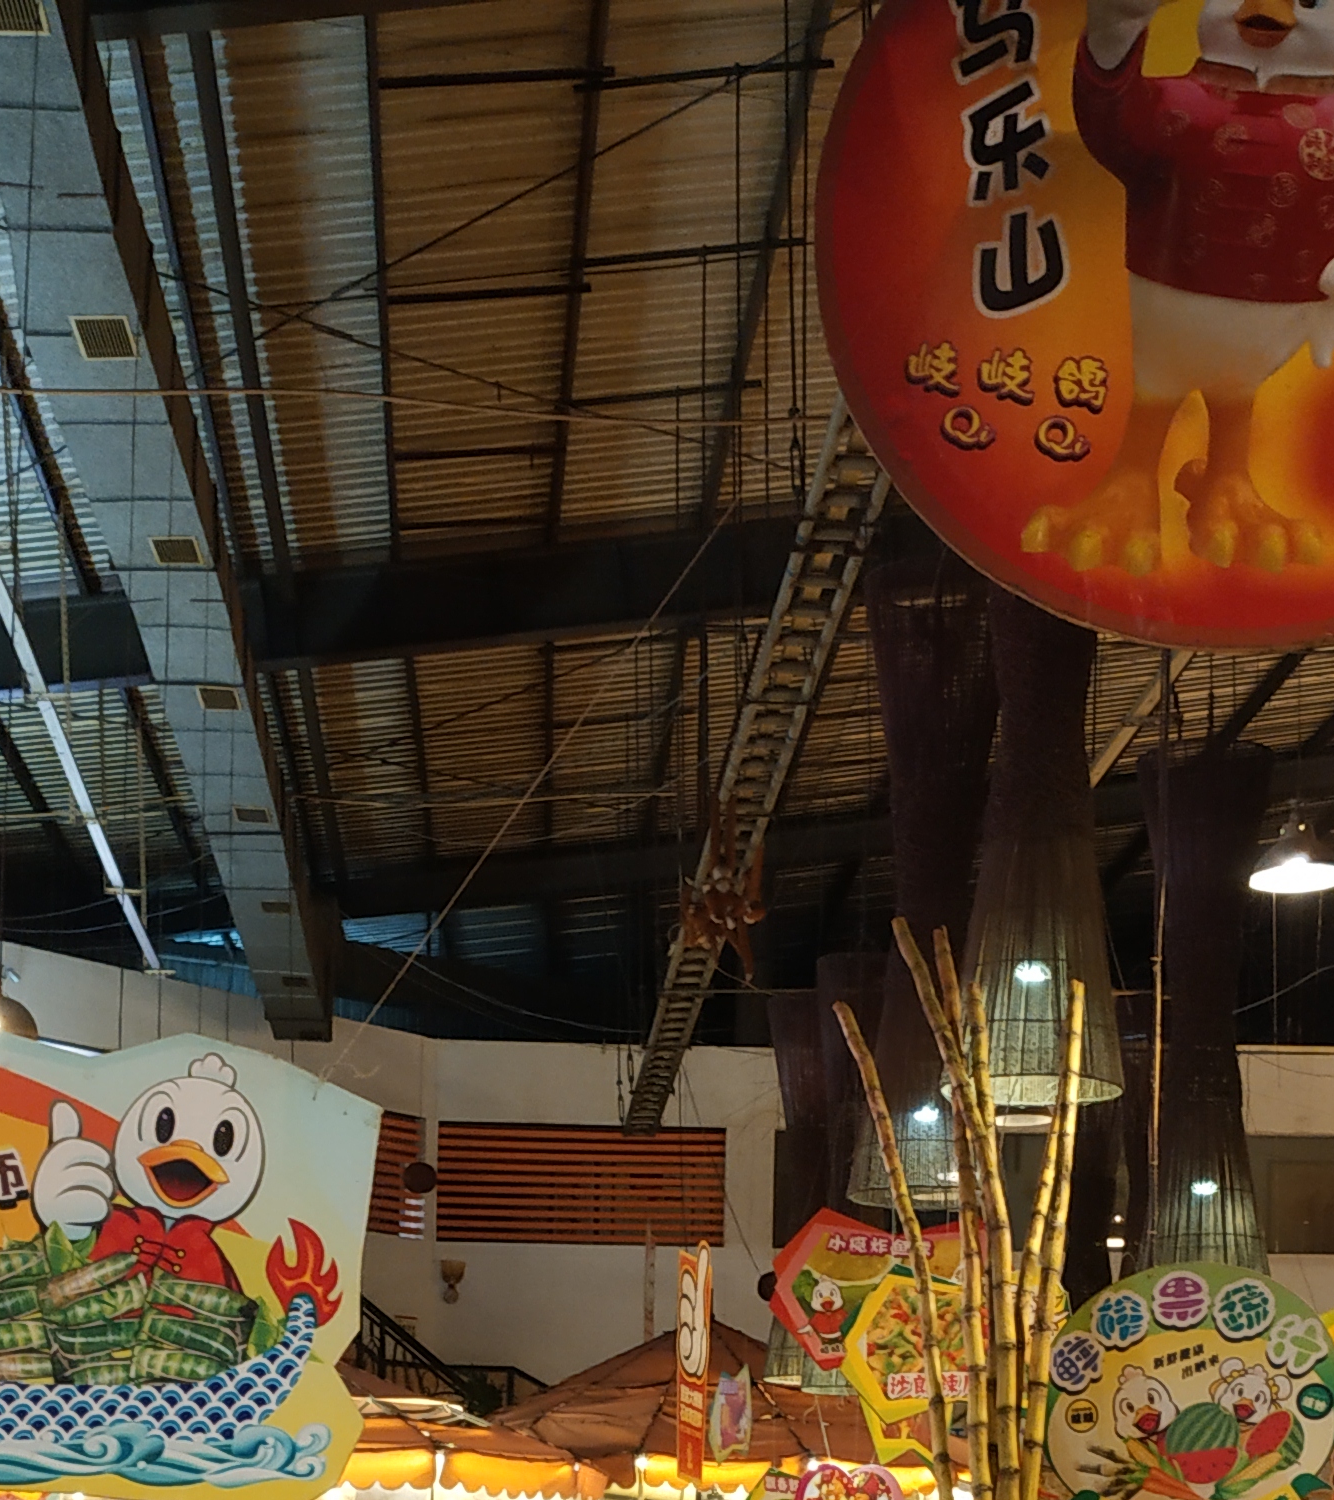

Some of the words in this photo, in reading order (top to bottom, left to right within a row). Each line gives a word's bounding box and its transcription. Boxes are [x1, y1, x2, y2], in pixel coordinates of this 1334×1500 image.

[906, 342, 1111, 414] 岐岐鸽
[940, 406, 995, 451] Qi
[1035, 416, 1090, 461] Qi
